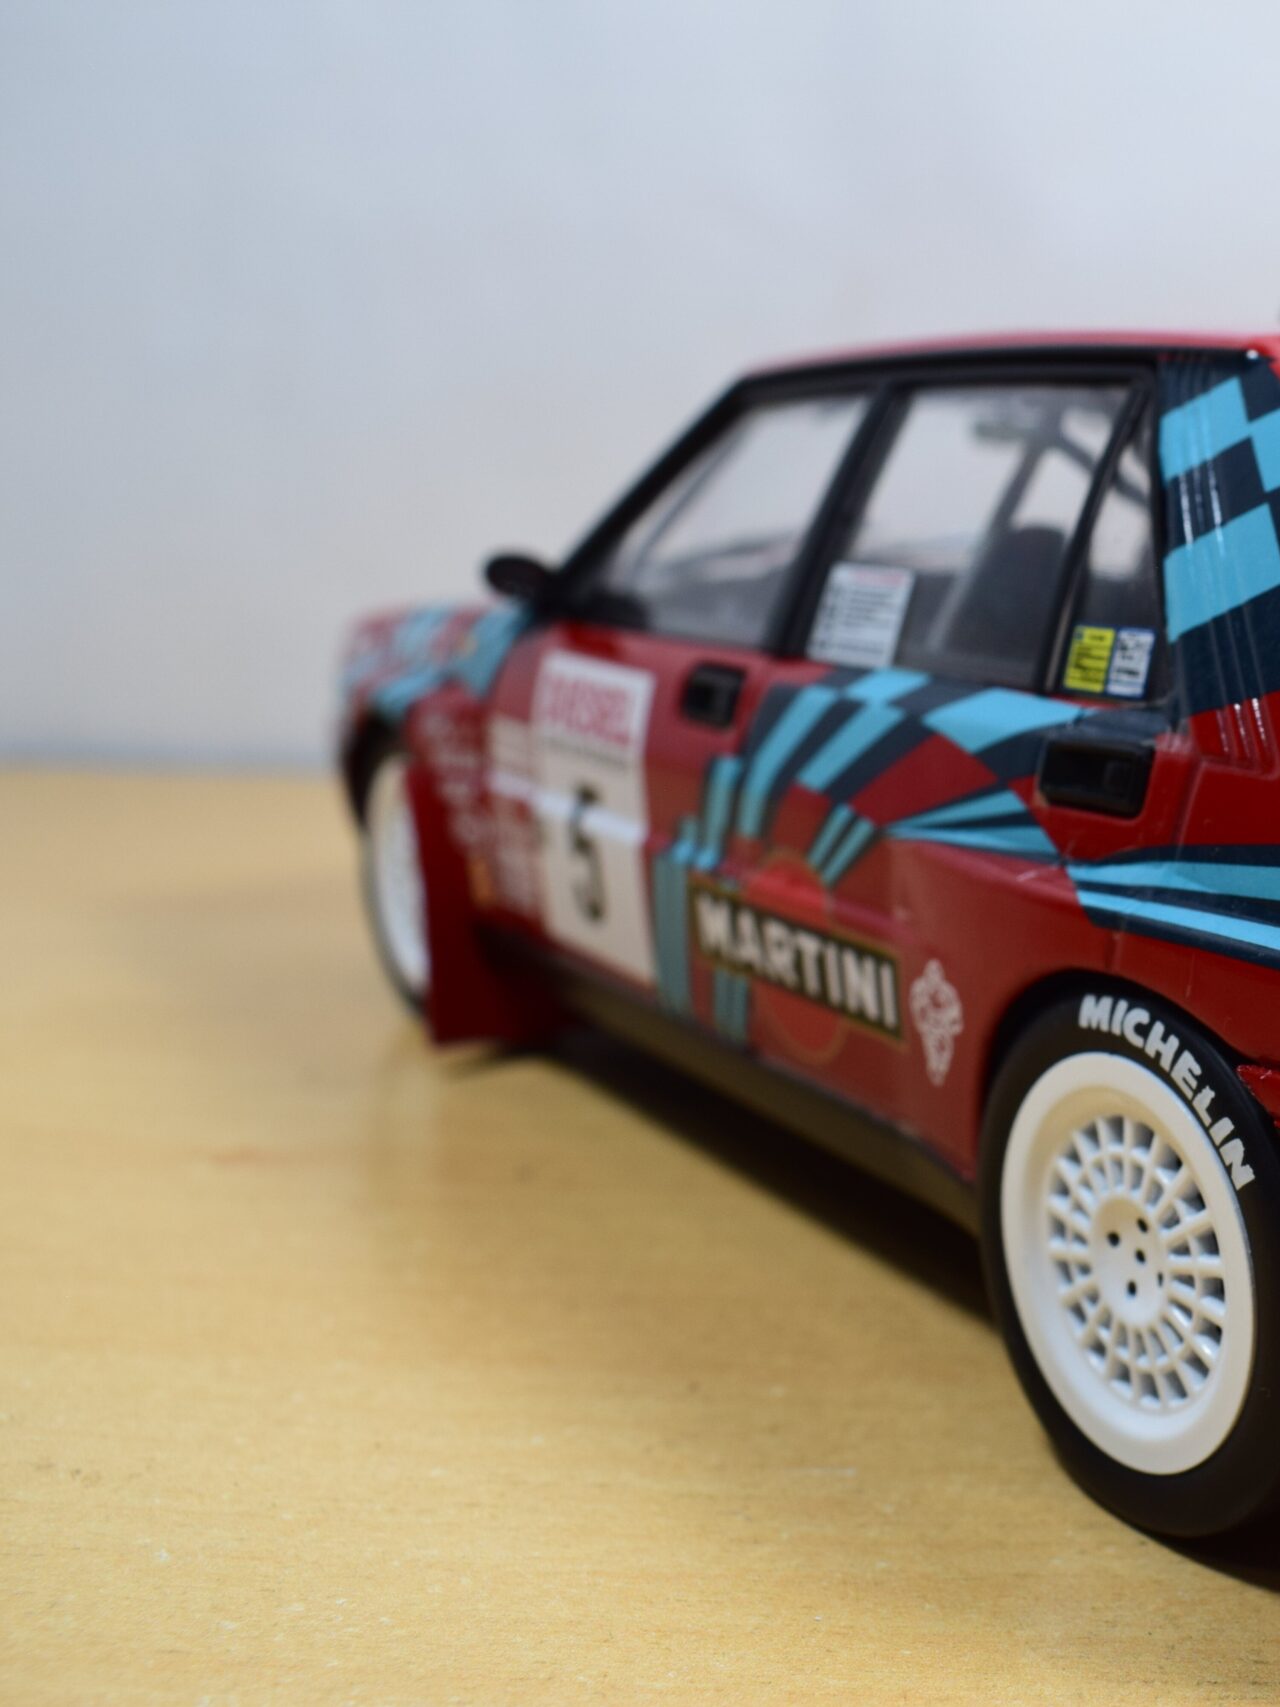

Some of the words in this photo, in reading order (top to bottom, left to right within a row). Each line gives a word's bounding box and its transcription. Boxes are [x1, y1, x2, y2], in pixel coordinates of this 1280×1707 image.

[571, 786, 608, 924] 5
[695, 892, 898, 1031] MARTINI
[1078, 994, 1255, 1191] MICHELIN
